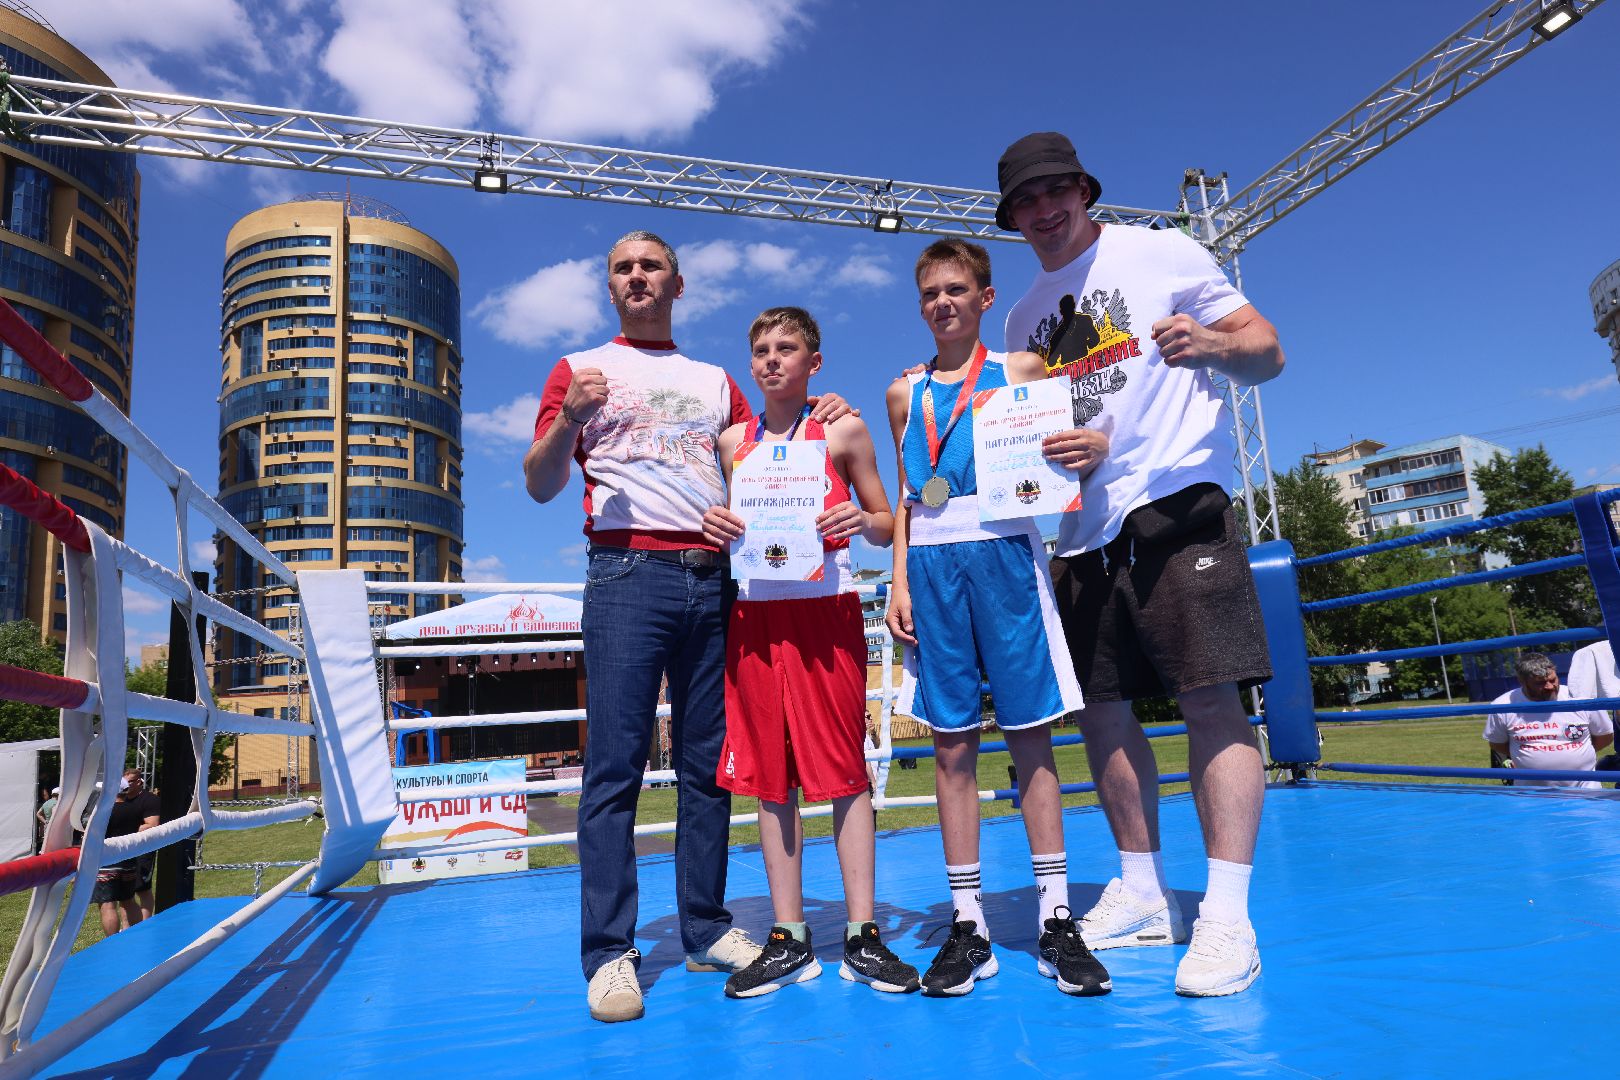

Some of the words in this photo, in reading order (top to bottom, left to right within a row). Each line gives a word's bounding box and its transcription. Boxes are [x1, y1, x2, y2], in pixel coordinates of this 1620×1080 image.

[1071, 370, 1111, 399] АВЯН
[740, 497, 815, 508] НАГРАЖДАЕТСЯ
[1198, 557, 1214, 566] NIKE
[419, 626, 450, 637] ДЕНЬ
[455, 623, 505, 635] ДРУЖБЫ
[511, 622, 518, 632] И
[396, 775, 445, 789] КУЛЬТУРЫ
[447, 774, 453, 785] И
[455, 772, 489, 784] СПОРТА
